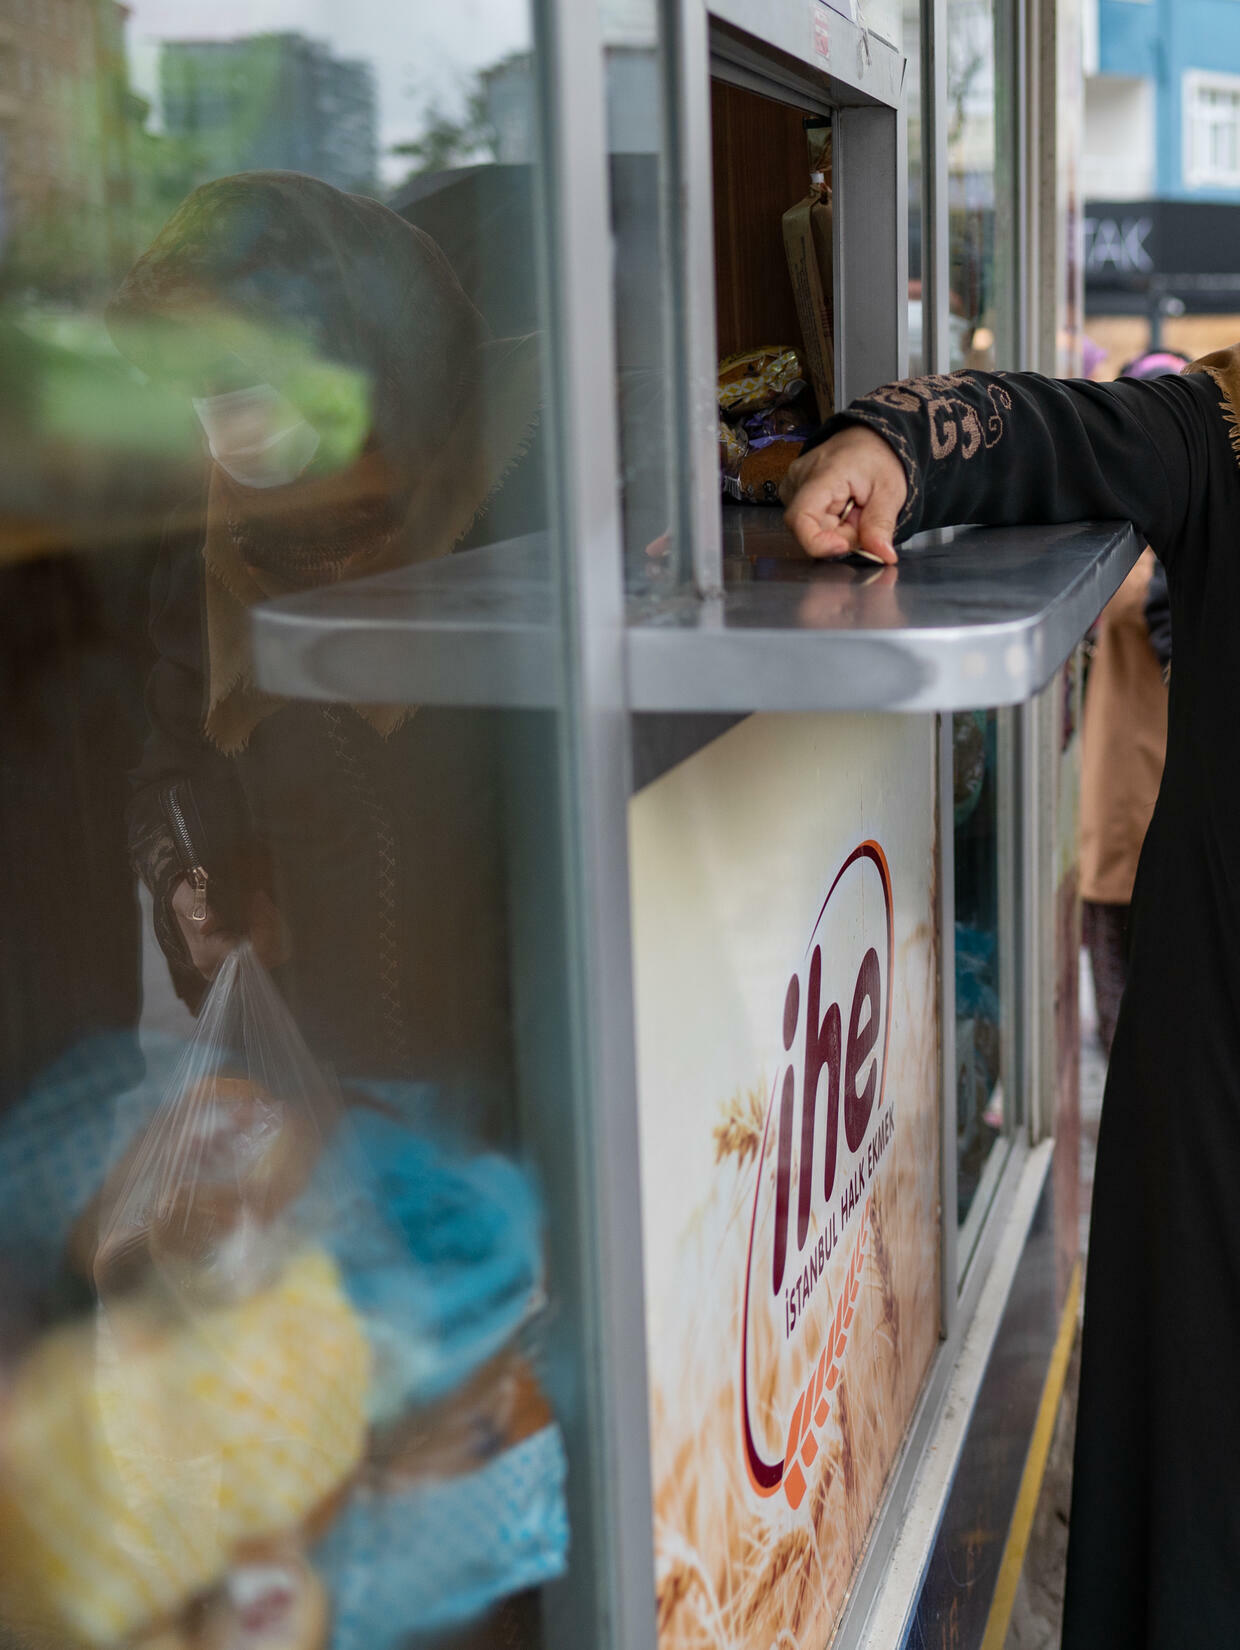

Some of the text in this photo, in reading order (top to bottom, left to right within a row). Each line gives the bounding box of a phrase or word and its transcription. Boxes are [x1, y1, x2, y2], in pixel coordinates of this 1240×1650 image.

[772, 944, 881, 1296] ihe
[785, 1100, 895, 1339] İSTANBUL HALK EKMEK
